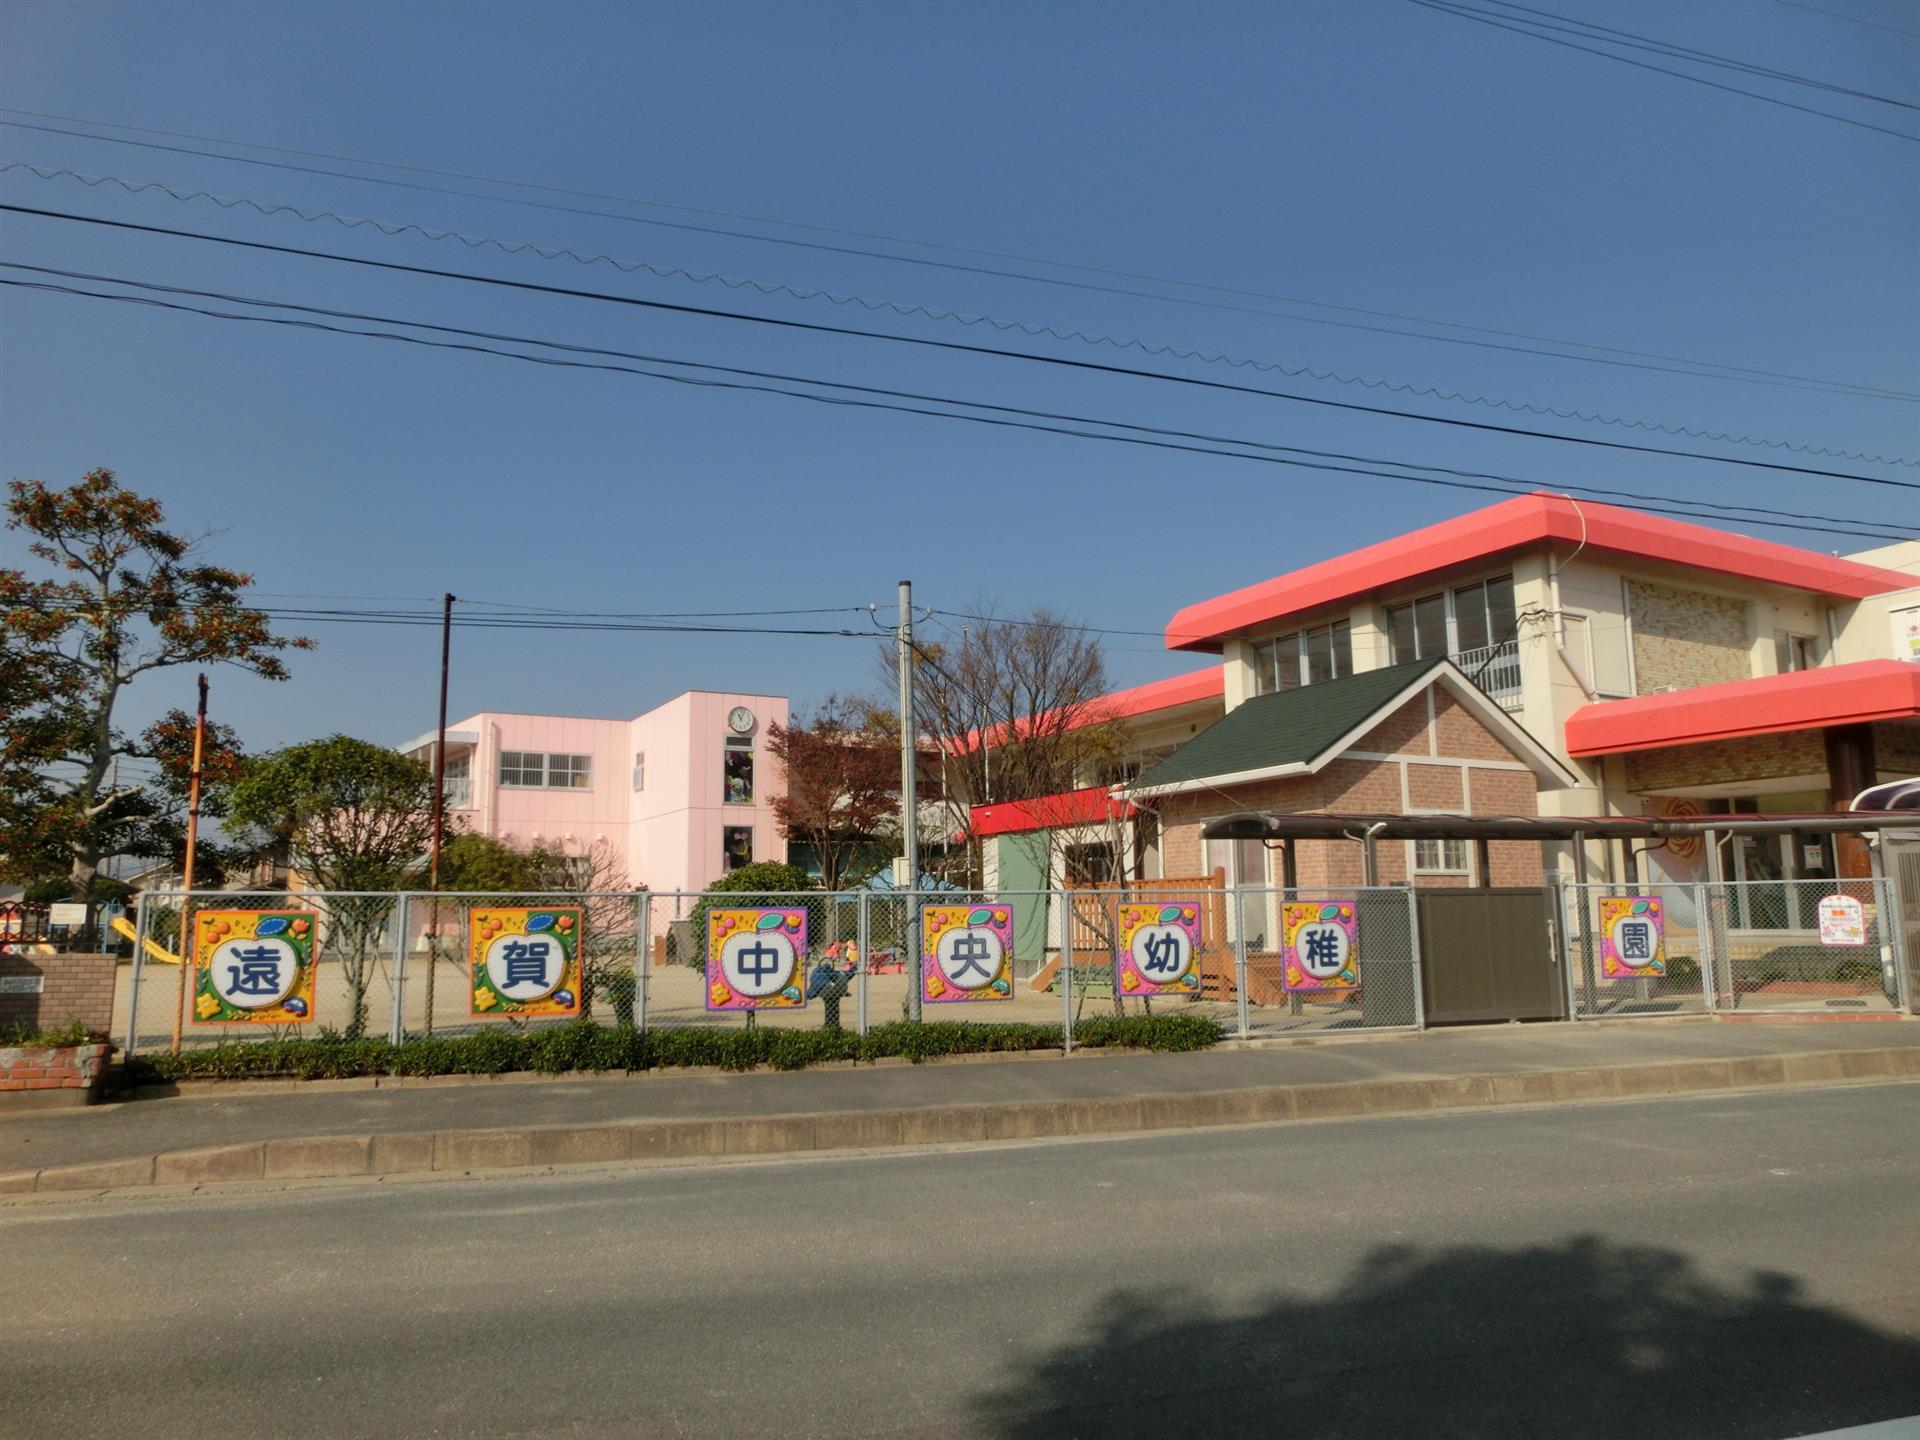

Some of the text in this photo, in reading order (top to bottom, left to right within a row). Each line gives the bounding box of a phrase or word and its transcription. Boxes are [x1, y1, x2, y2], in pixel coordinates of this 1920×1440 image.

[738, 941, 779, 987] 中
[951, 934, 991, 979] 央
[1145, 932, 1180, 973] 幼
[1306, 930, 1340, 969] 稚
[1623, 924, 1650, 959] 園
[227, 946, 282, 995] 遠
[503, 941, 550, 989] 賀
